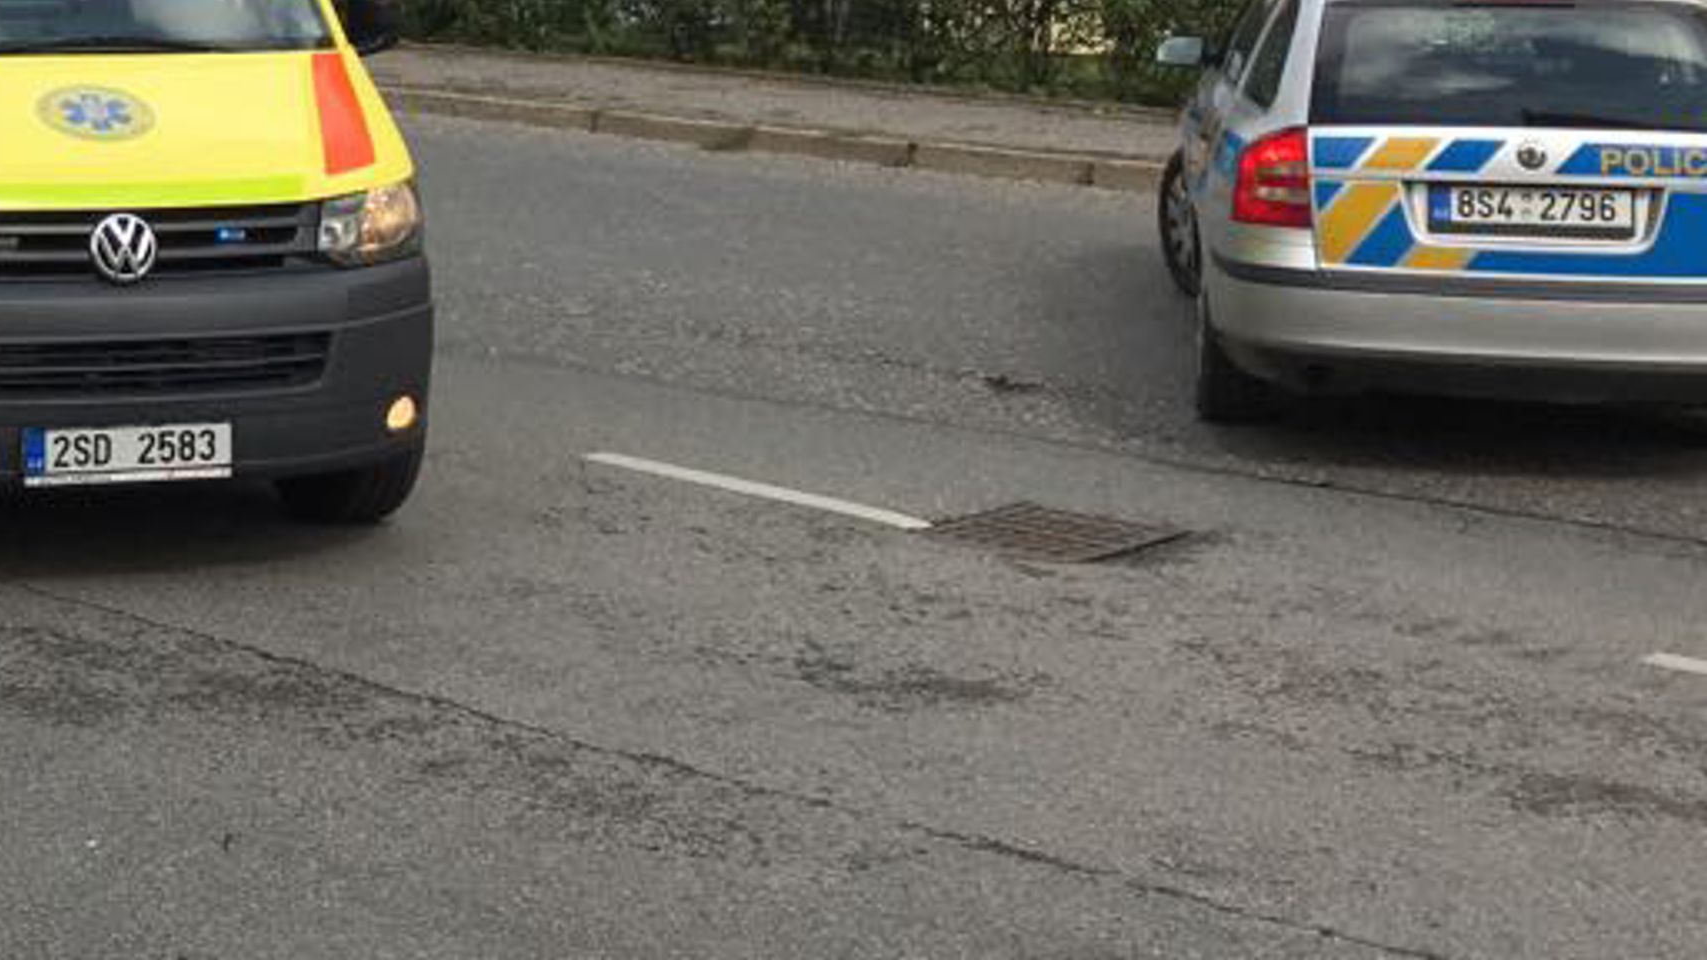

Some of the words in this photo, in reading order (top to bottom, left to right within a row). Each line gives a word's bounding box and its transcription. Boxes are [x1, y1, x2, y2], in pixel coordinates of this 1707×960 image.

[1457, 190, 1513, 219] 8S4
[1540, 192, 1617, 222] 2796
[53, 433, 113, 469] 2SD
[137, 429, 216, 465] 2583
